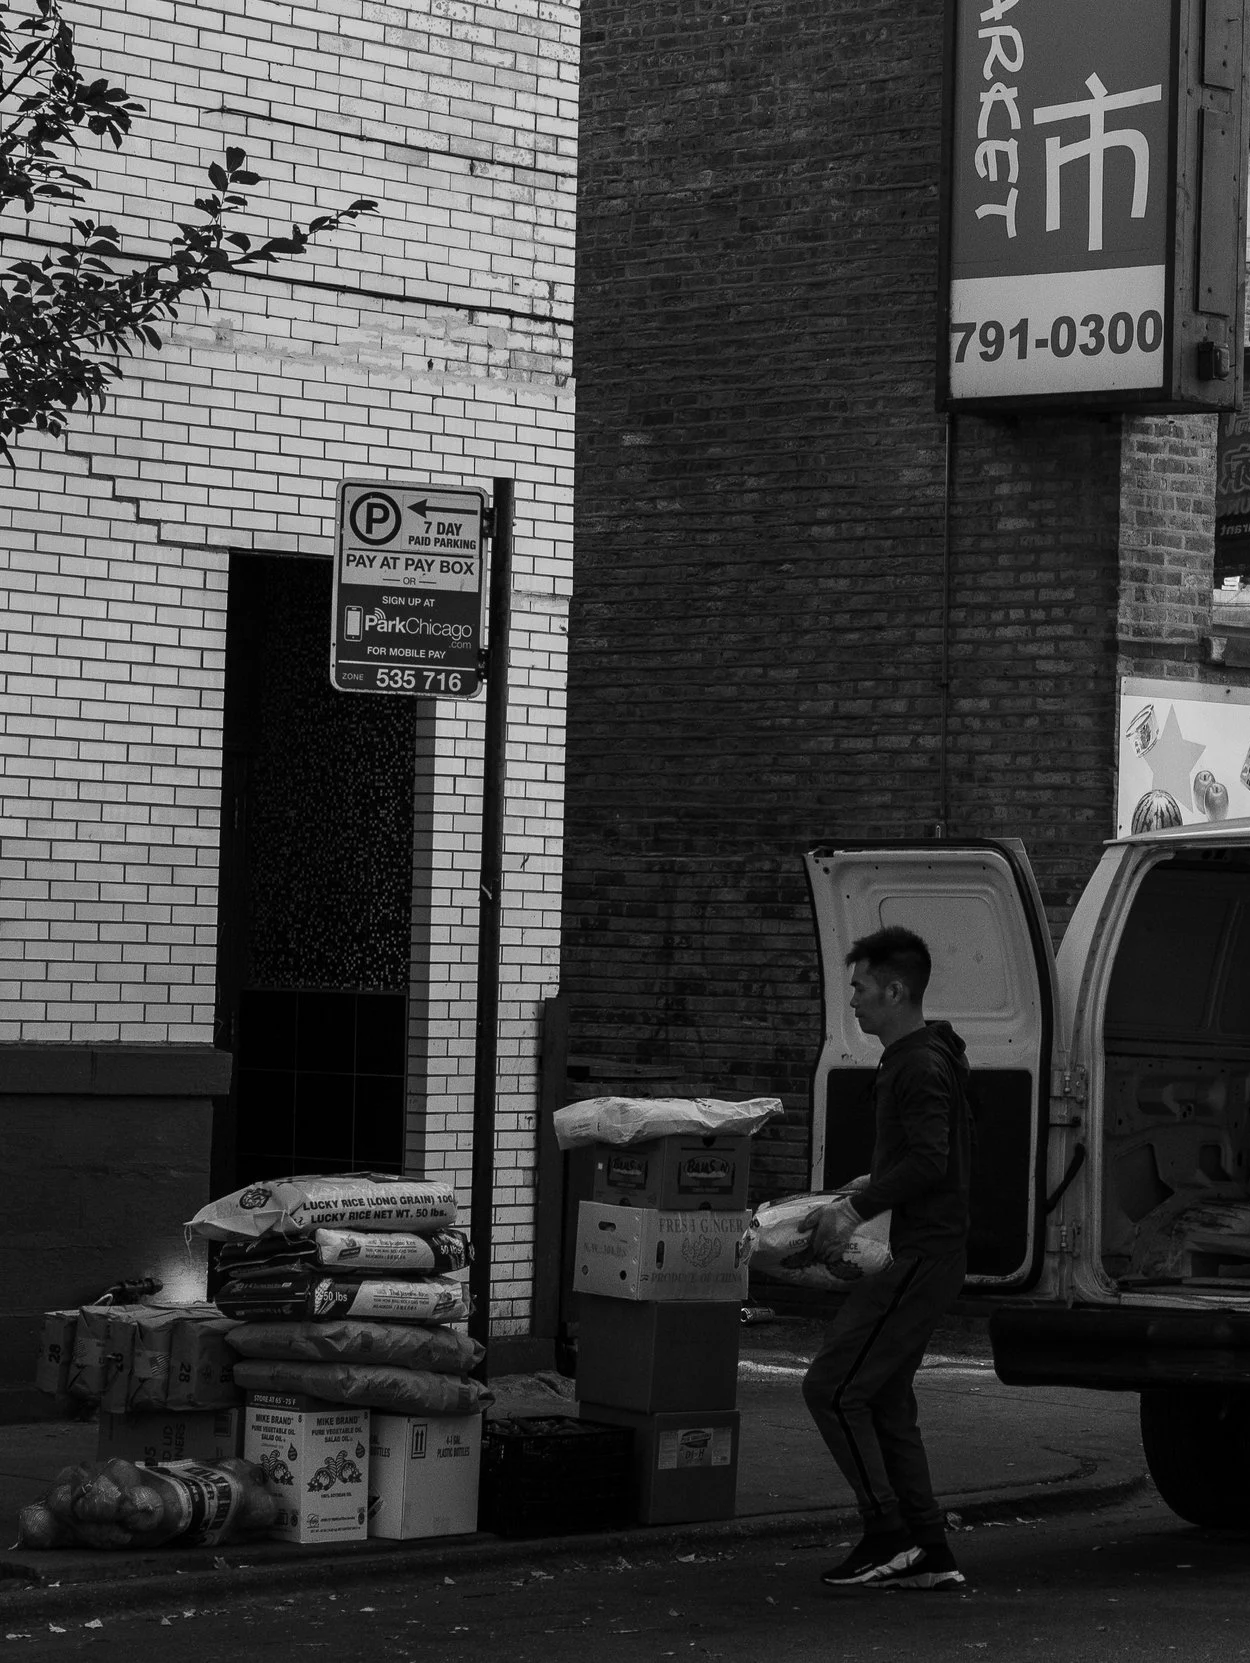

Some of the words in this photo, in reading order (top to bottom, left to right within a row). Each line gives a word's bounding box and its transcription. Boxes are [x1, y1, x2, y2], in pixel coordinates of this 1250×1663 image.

[951, 309, 1163, 364] 791-0300
[423, 521, 433, 535] 7
[436, 522, 463, 536] DAY
[408, 535, 431, 547] PAID
[434, 537, 477, 550] PARKING
[345, 554, 377, 569] PAY
[379, 556, 400, 570] AT
[404, 558, 435, 573] PAY
[439, 561, 475, 575] BOX
[402, 577, 417, 586] OR
[382, 595, 404, 605] SIGN
[406, 597, 421, 606] UP
[423, 599, 436, 607] AT
[364, 614, 473, 640] ParkChicago
[449, 640, 472, 650] .com
[367, 646, 387, 656] FOR
[389, 647, 426, 658] MOBILE
[428, 649, 446, 660] PAY
[342, 672, 364, 682] ZONE
[376, 668, 416, 688] 535
[422, 671, 462, 692] 716
[303, 1200, 339, 1211] LUCKY
[342, 1198, 365, 1208] RICE
[367, 1196, 398, 1208] (LONG
[400, 1195, 435, 1206] GRAIN)
[311, 1212, 346, 1224] LUCKY
[349, 1210, 371, 1221] RICE
[374, 1210, 394, 1220] NET
[396, 1209, 413, 1219] WT.
[416, 1208, 428, 1218] 50
[430, 1208, 447, 1217] lbs.
[700, 1219, 744, 1233] GINGER
[323, 1291, 333, 1302] 50
[335, 1291, 348, 1302] lbs
[179, 1362, 191, 1383] 28
[255, 1413, 270, 1423] MIKE
[271, 1414, 292, 1425] BRAND
[316, 1417, 334, 1426] MIKE
[336, 1416, 358, 1426] BRAND
[263, 1426, 287, 1435] VEGETABLE
[312, 1429, 325, 1437] PURE
[326, 1427, 354, 1436] VEGETABLE
